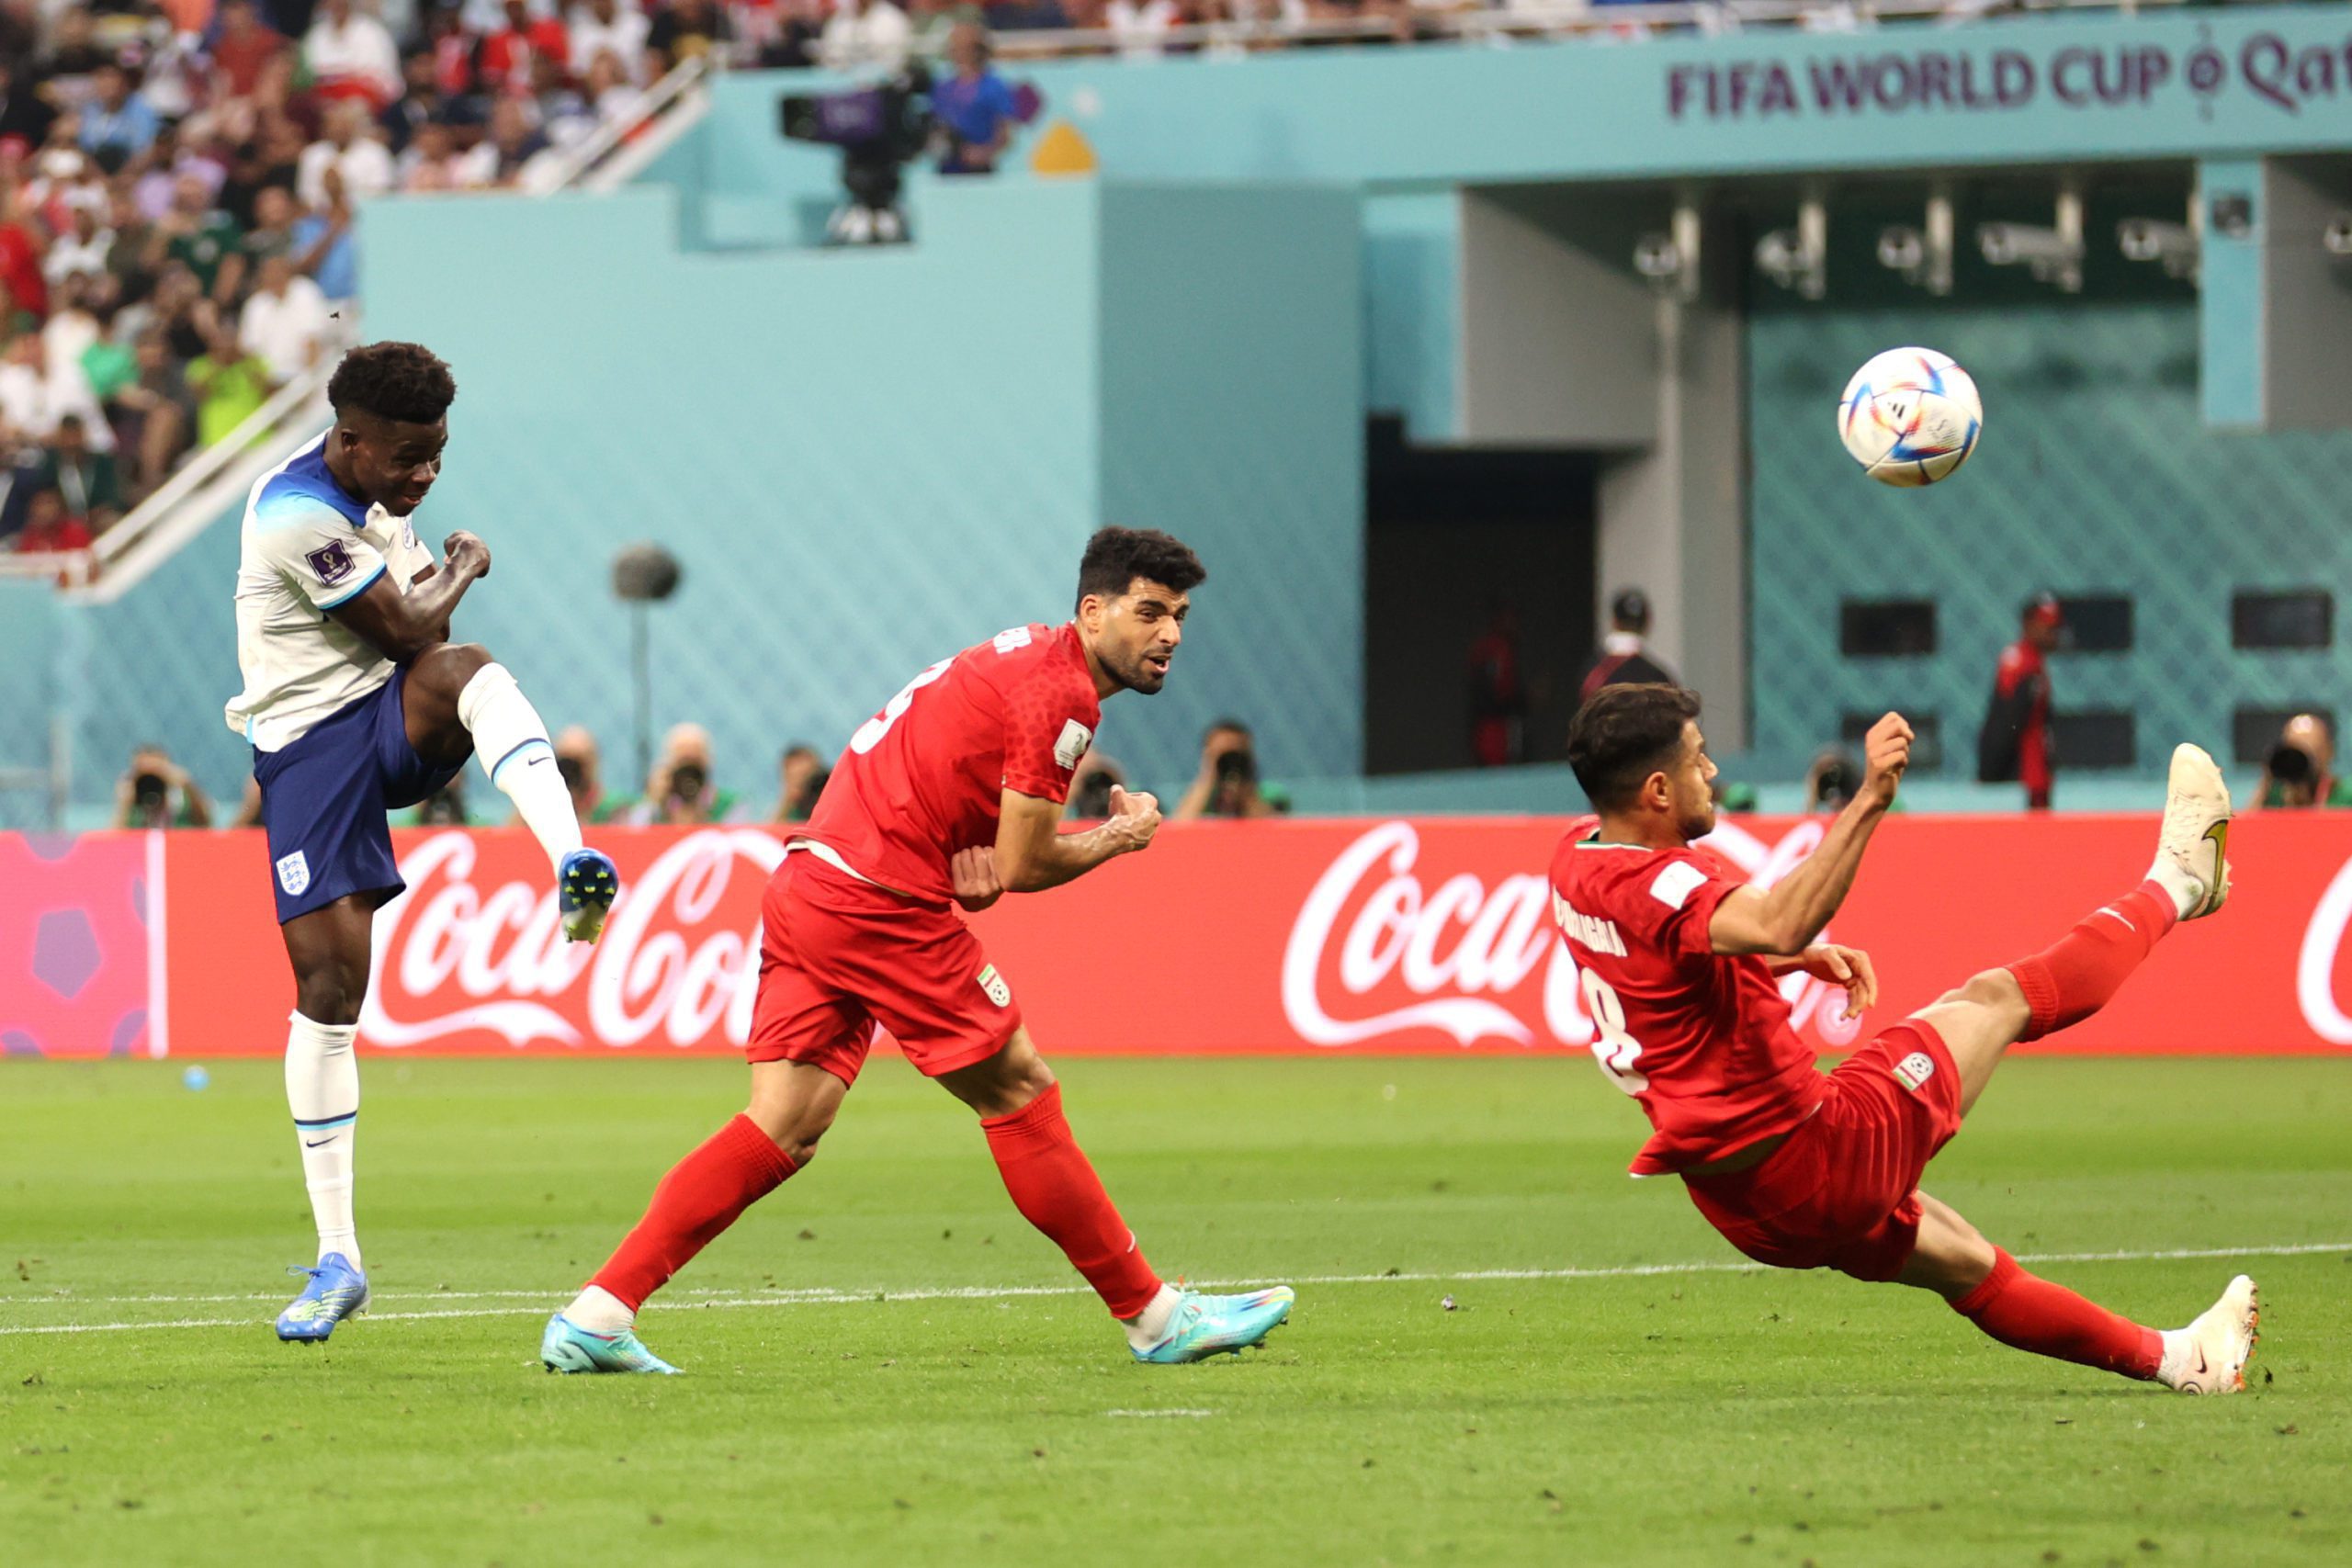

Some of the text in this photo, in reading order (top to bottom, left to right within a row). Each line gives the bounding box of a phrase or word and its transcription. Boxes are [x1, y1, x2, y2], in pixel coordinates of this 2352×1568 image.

[1667, 60, 1799, 121] FIFA
[1807, 48, 2035, 113] WORLD
[2050, 42, 2172, 108] CUP
